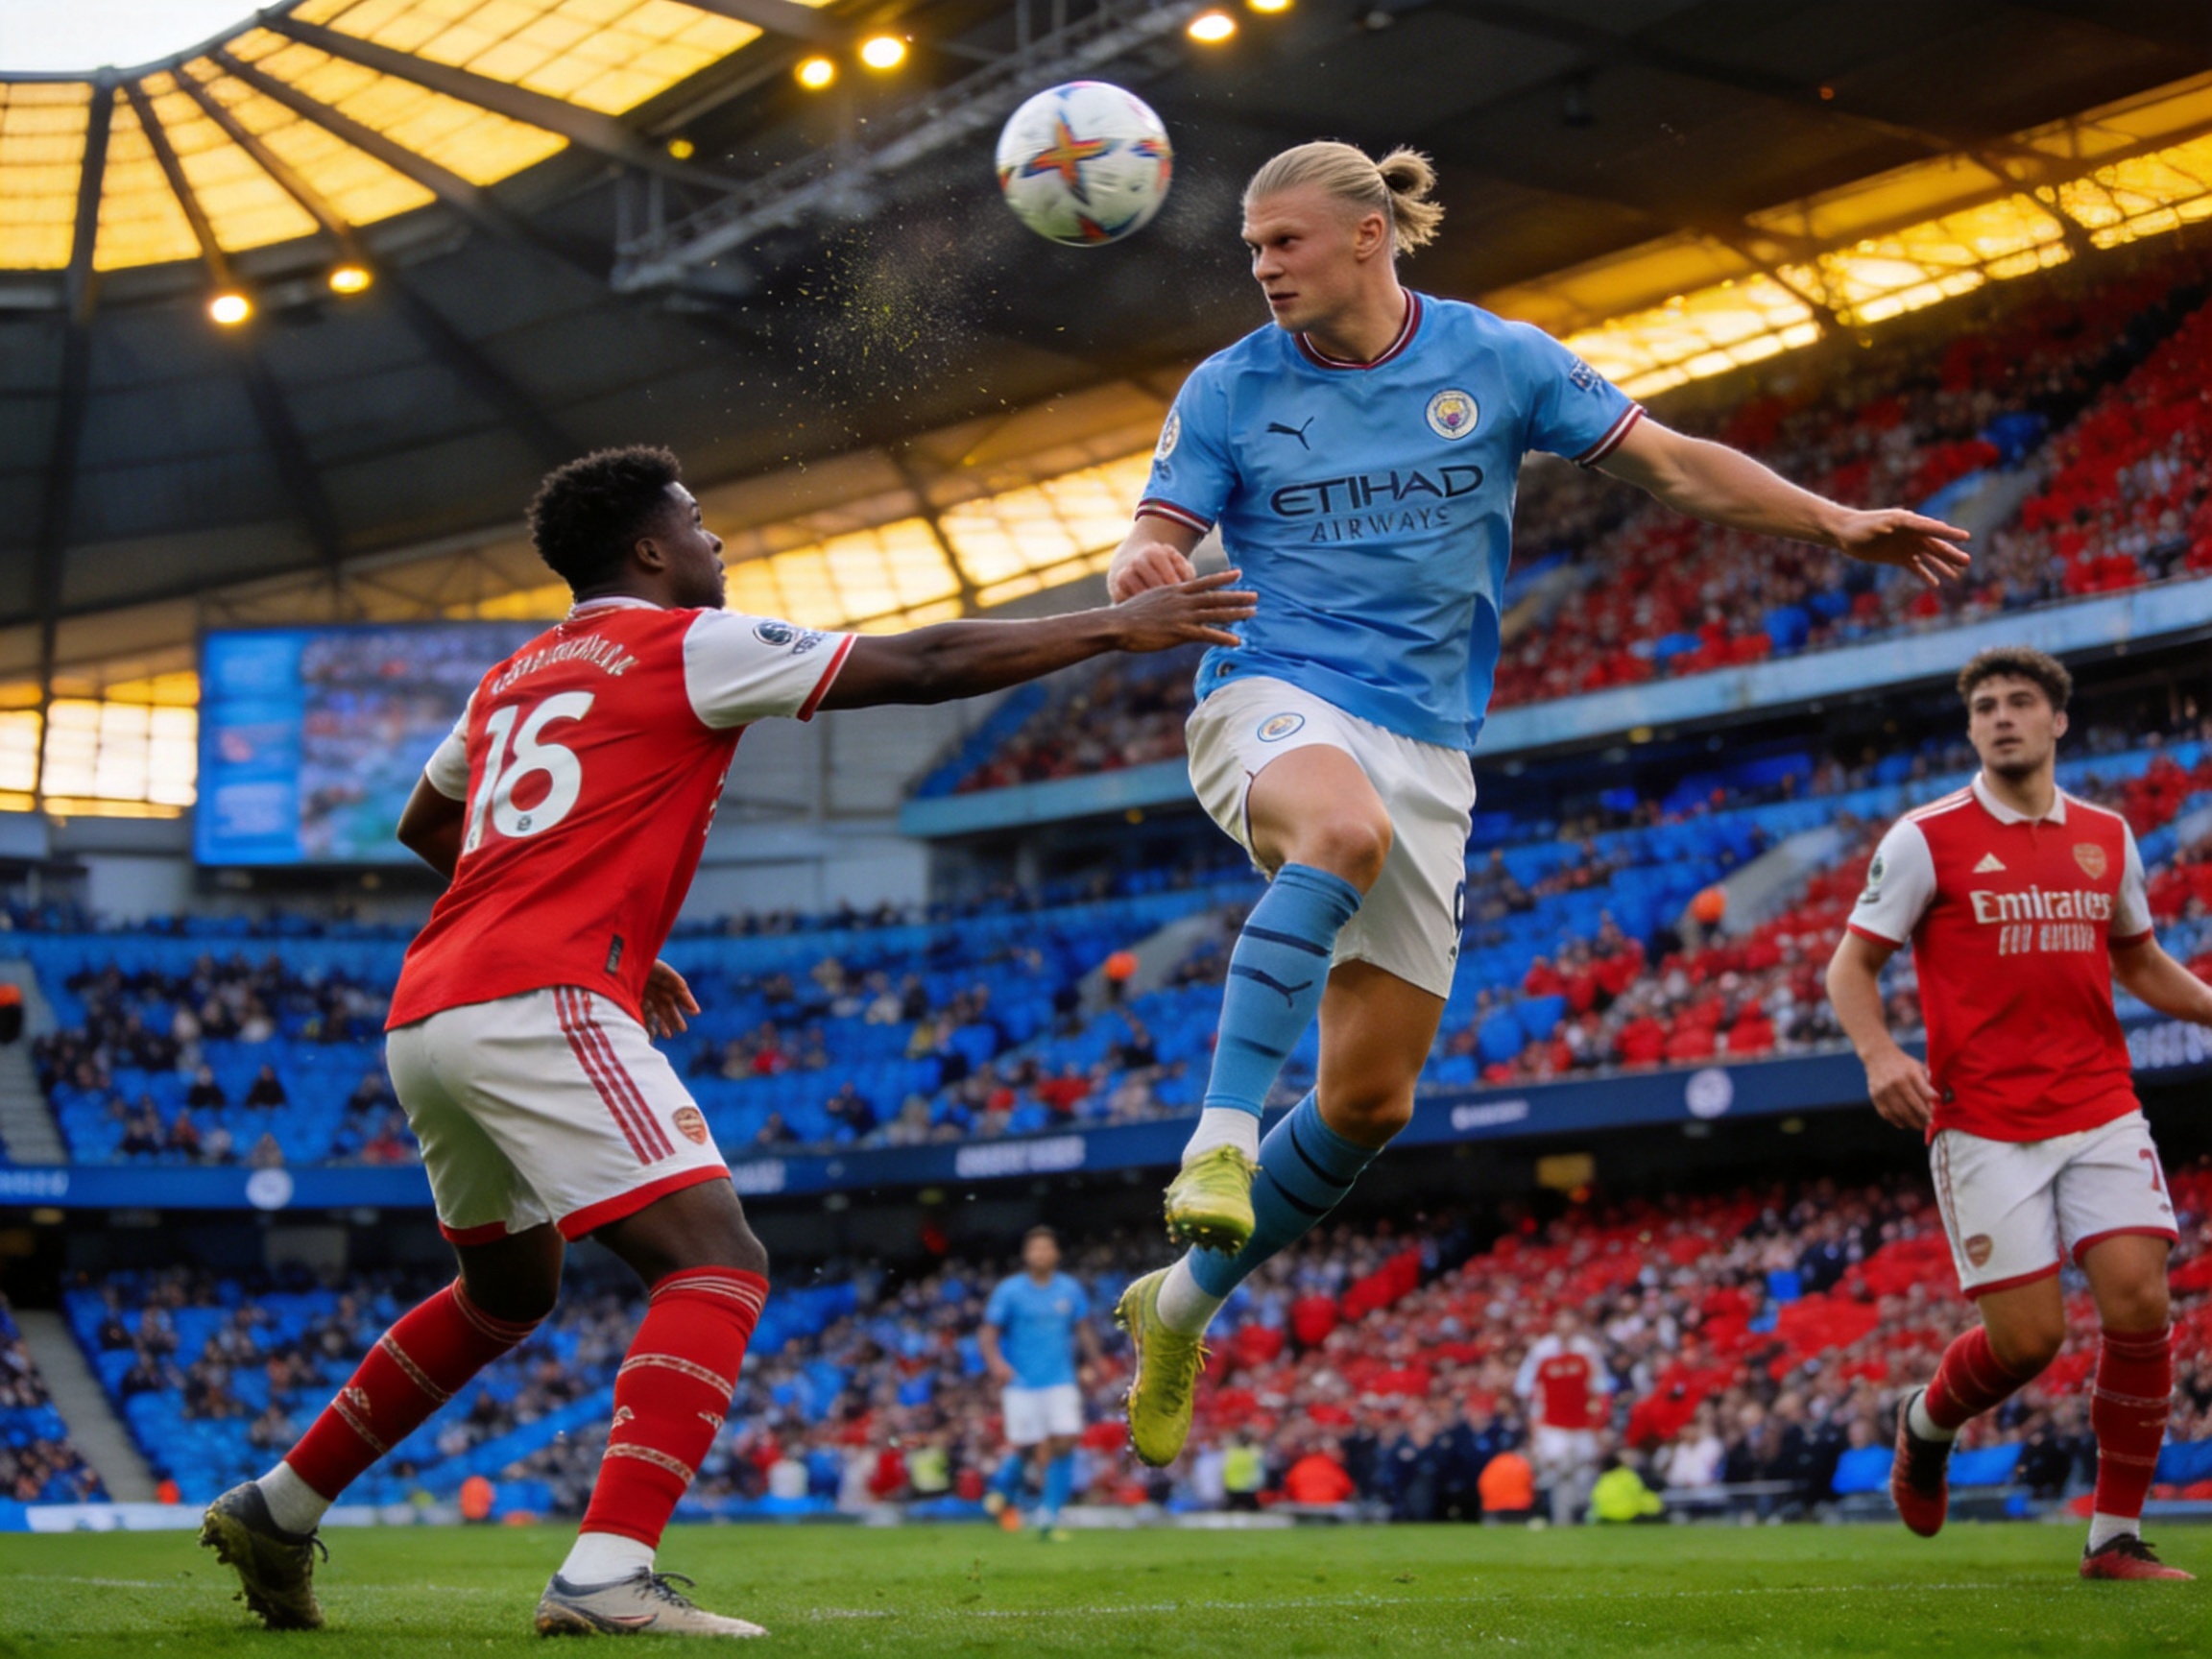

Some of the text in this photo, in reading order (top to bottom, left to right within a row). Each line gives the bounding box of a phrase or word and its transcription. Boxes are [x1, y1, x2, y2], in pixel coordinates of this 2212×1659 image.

[1270, 465, 1483, 517] ETIHAD
[1310, 506, 1451, 543] AIRWAYS
[462, 690, 595, 856] 16
[1969, 883, 2112, 925] Emirates
